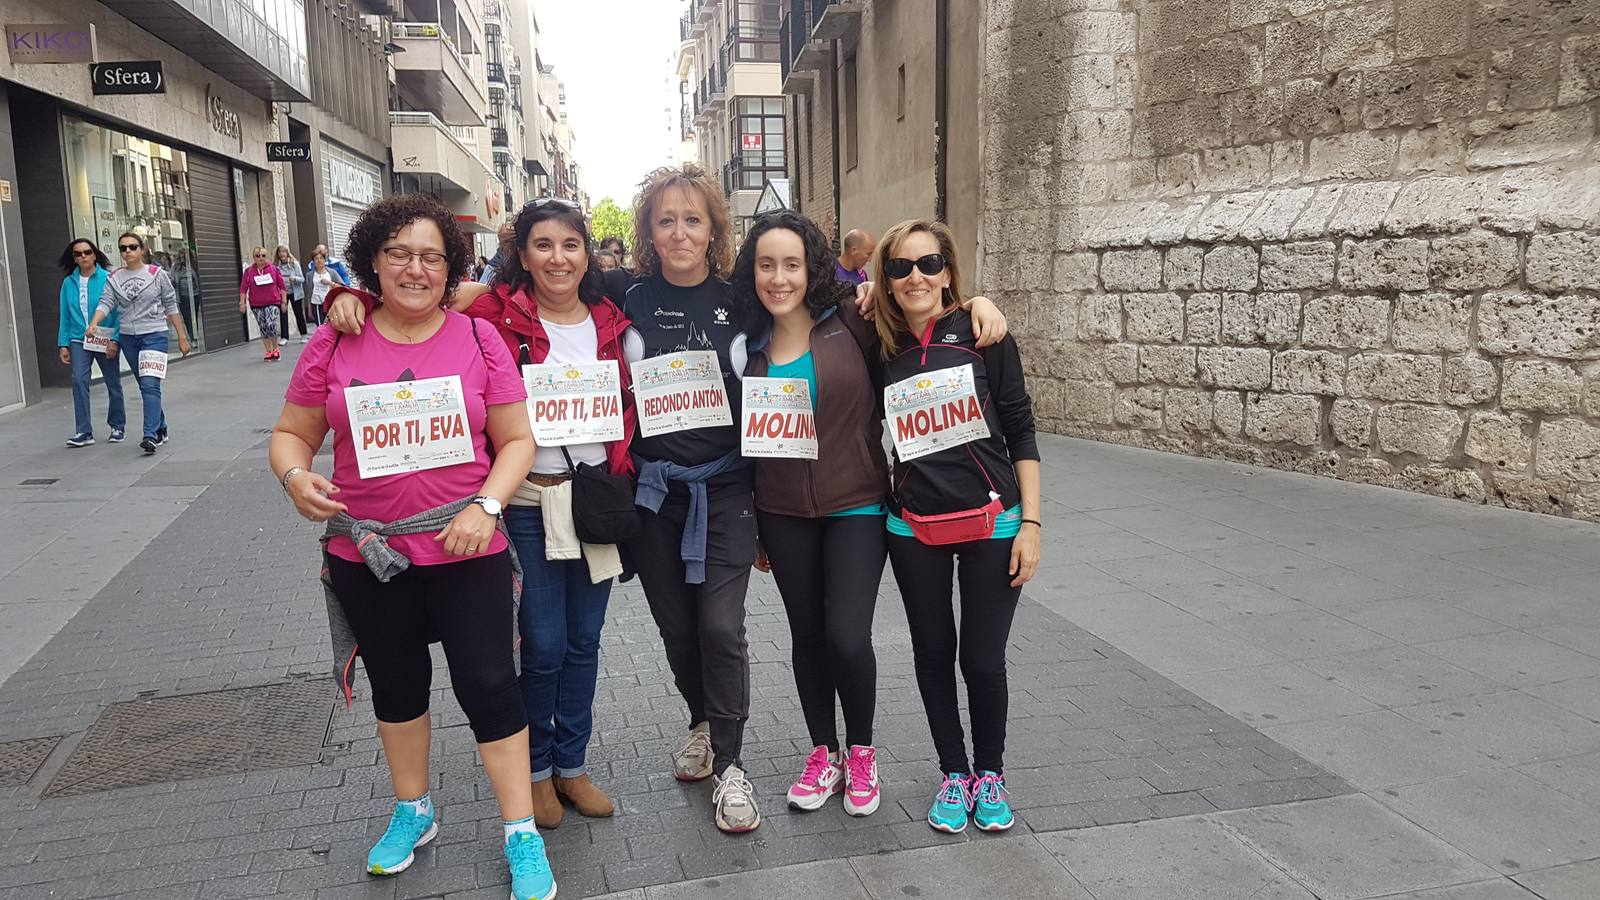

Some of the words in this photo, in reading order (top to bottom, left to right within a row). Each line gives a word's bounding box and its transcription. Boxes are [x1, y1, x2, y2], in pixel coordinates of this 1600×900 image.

[12, 31, 87, 49] KIKO
[535, 399, 568, 422] POR
[572, 398, 588, 422] TI,
[592, 395, 619, 418] EVA
[644, 391, 690, 417] REDONDO
[692, 384, 723, 409] ANTÓN
[362, 423, 400, 450] POR
[405, 419, 425, 446] TI,
[430, 413, 464, 441] EVA
[746, 412, 816, 440] MOLINA
[896, 395, 982, 443] MOLINA
